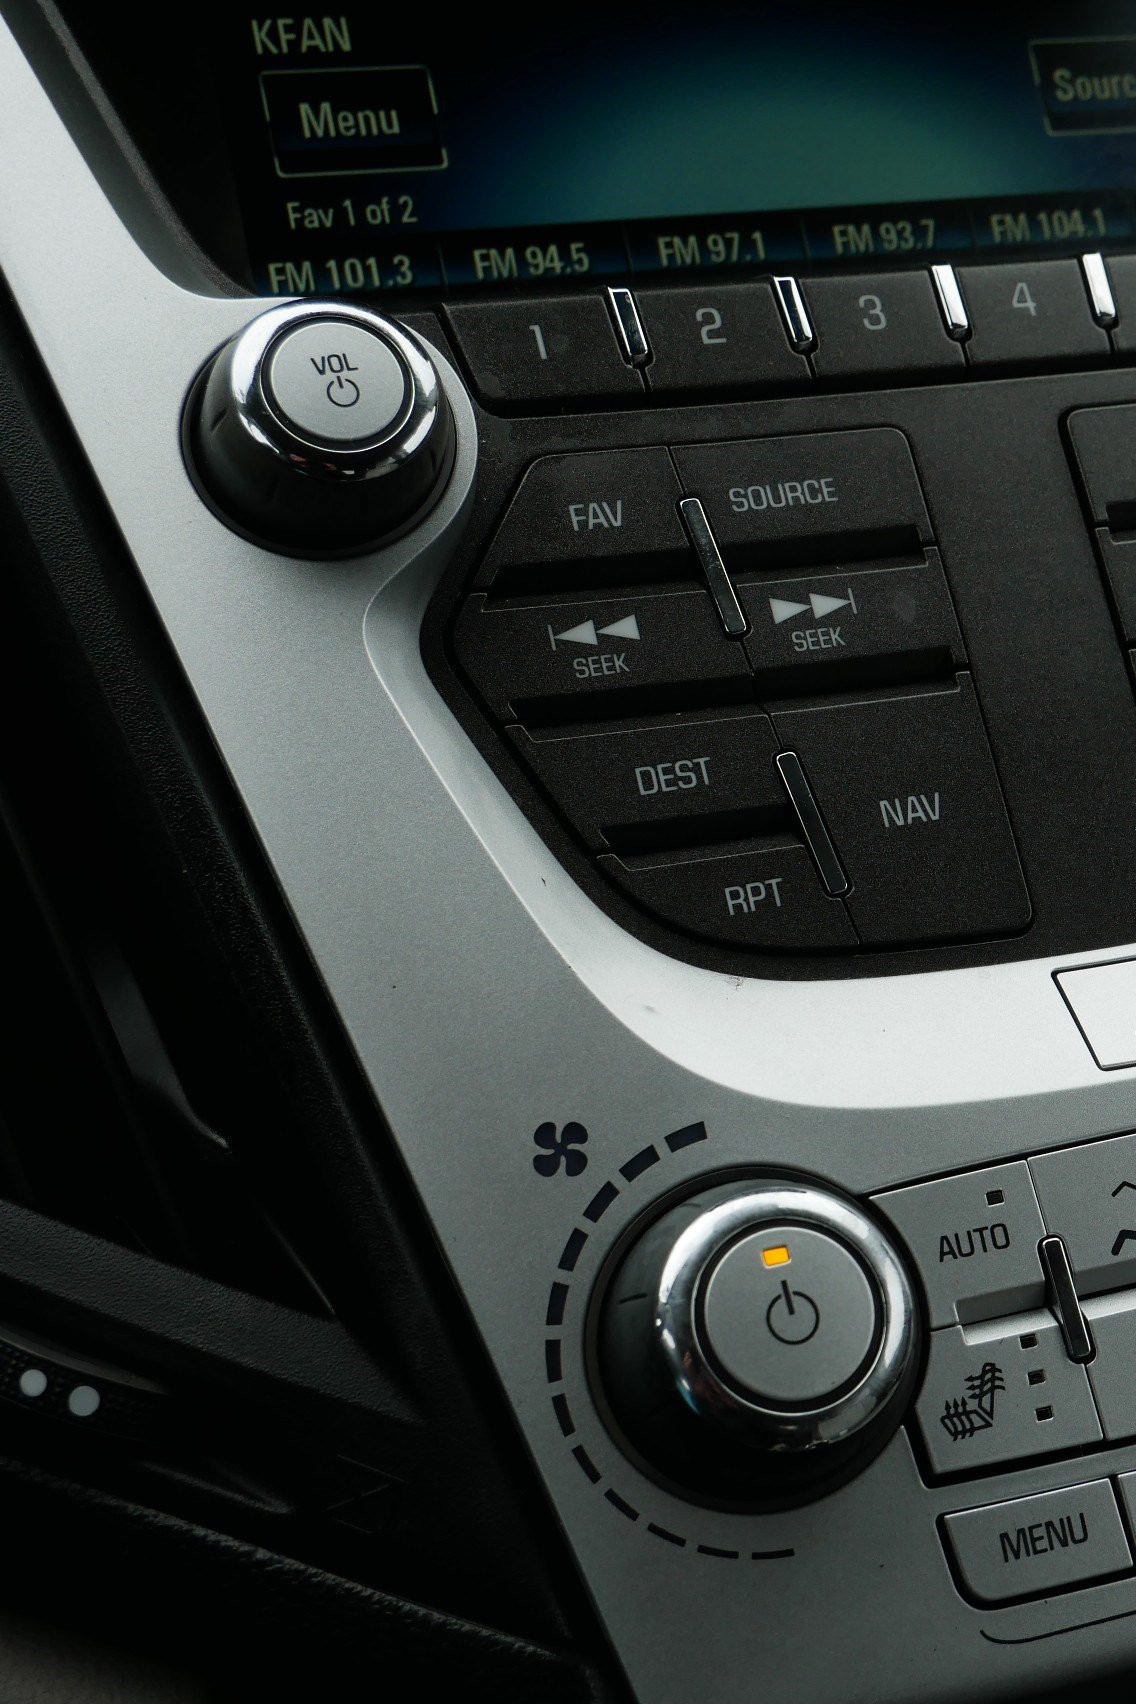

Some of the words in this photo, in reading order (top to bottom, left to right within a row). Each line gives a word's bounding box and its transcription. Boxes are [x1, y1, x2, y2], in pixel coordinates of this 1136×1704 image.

[251, 16, 352, 55] KFAN
[299, 102, 400, 139] Menu
[287, 201, 334, 230] Fav
[342, 200, 356, 227] 1
[366, 198, 391, 224] of
[398, 196, 418, 223] 2
[989, 212, 1031, 243] FM
[1036, 207, 1107, 240] 104.1
[657, 234, 701, 267] FM
[707, 231, 768, 262] 97.1
[832, 223, 874, 255] FM
[879, 218, 936, 250] 93.7
[267, 259, 316, 295] FM
[325, 253, 414, 291] 101.3
[473, 248, 517, 280] FM
[524, 242, 590, 275] 94.5
[858, 294, 888, 331] 3
[1011, 282, 1037, 317] 4
[529, 324, 548, 360] 1
[696, 307, 728, 345] 2
[310, 353, 359, 376] VOL
[728, 477, 839, 513] SOURCE
[568, 500, 623, 532] FAV
[790, 626, 847, 653] SEEK
[572, 652, 631, 679] SEEK
[634, 756, 711, 796] DEST
[879, 792, 942, 829] NAV
[723, 877, 784, 916] RPT
[936, 1222, 1011, 1263] AUTO
[999, 1511, 1090, 1564] MENU
